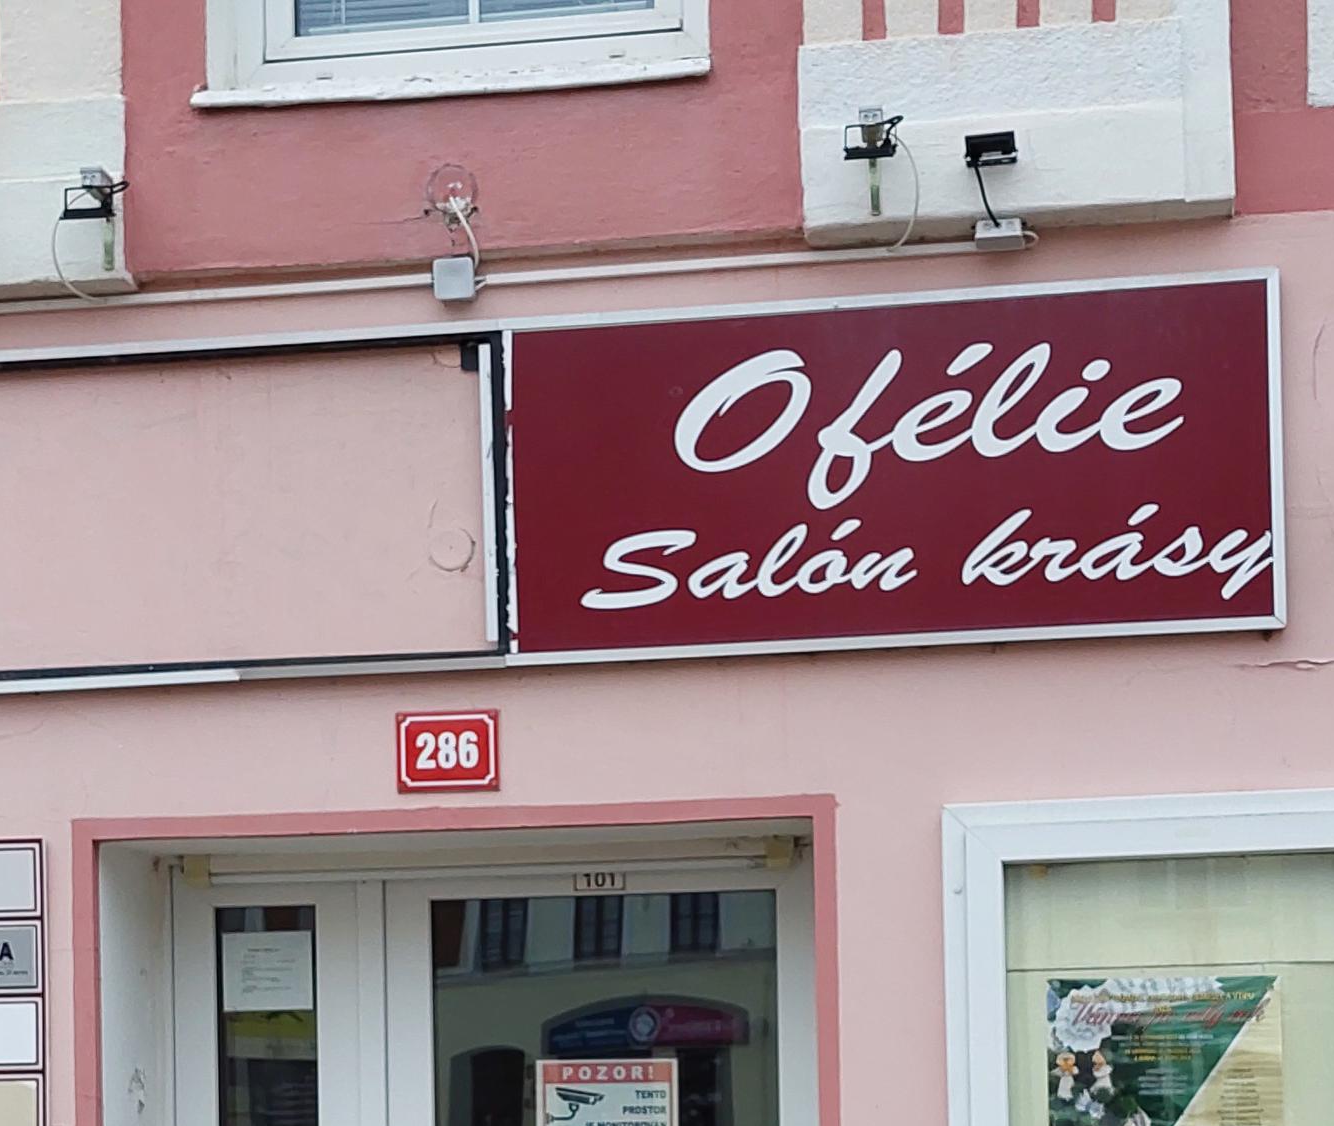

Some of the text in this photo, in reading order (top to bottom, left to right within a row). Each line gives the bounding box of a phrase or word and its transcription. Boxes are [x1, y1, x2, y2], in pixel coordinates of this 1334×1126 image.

[673, 341, 1185, 510] Ofélie
[580, 502, 1274, 610] Salón krásy
[415, 730, 479, 770] 286
[583, 871, 616, 888] 101
[562, 1065, 654, 1081] POZOR!
[634, 1089, 667, 1100] TENTO
